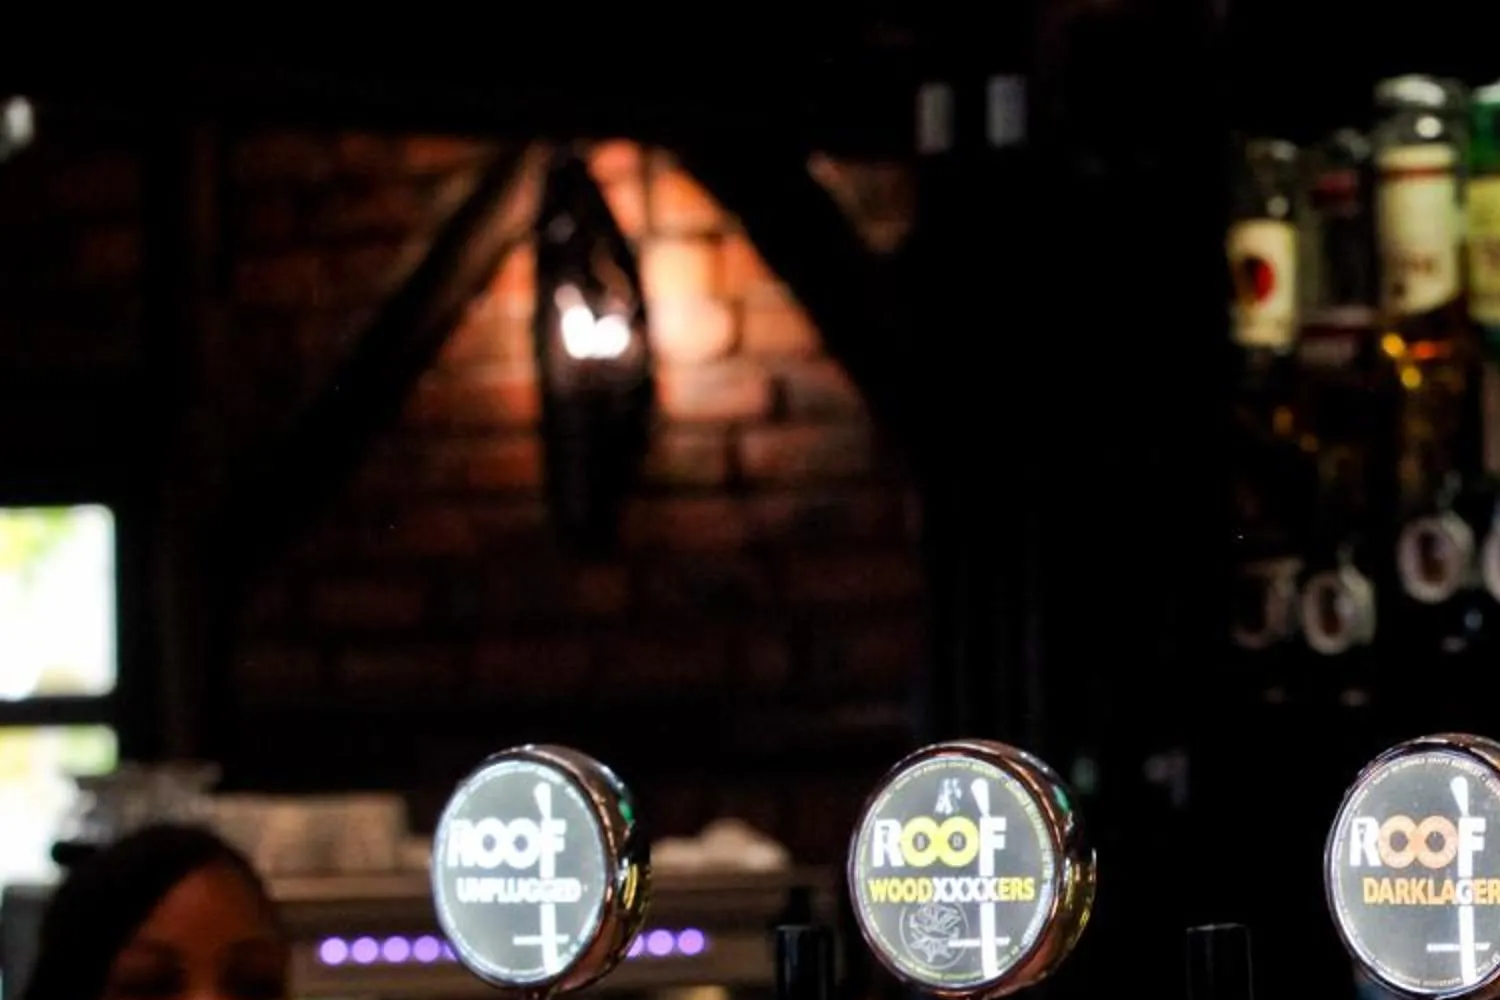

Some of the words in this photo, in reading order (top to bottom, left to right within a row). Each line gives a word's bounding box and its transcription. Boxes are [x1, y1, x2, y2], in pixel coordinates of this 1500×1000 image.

[447, 816, 568, 874] ROOF
[871, 815, 1008, 873] ROOF
[1349, 814, 1488, 874] ROOF
[455, 876, 583, 903] UNPLUGGED
[867, 875, 1036, 903] WOODXXXXERS
